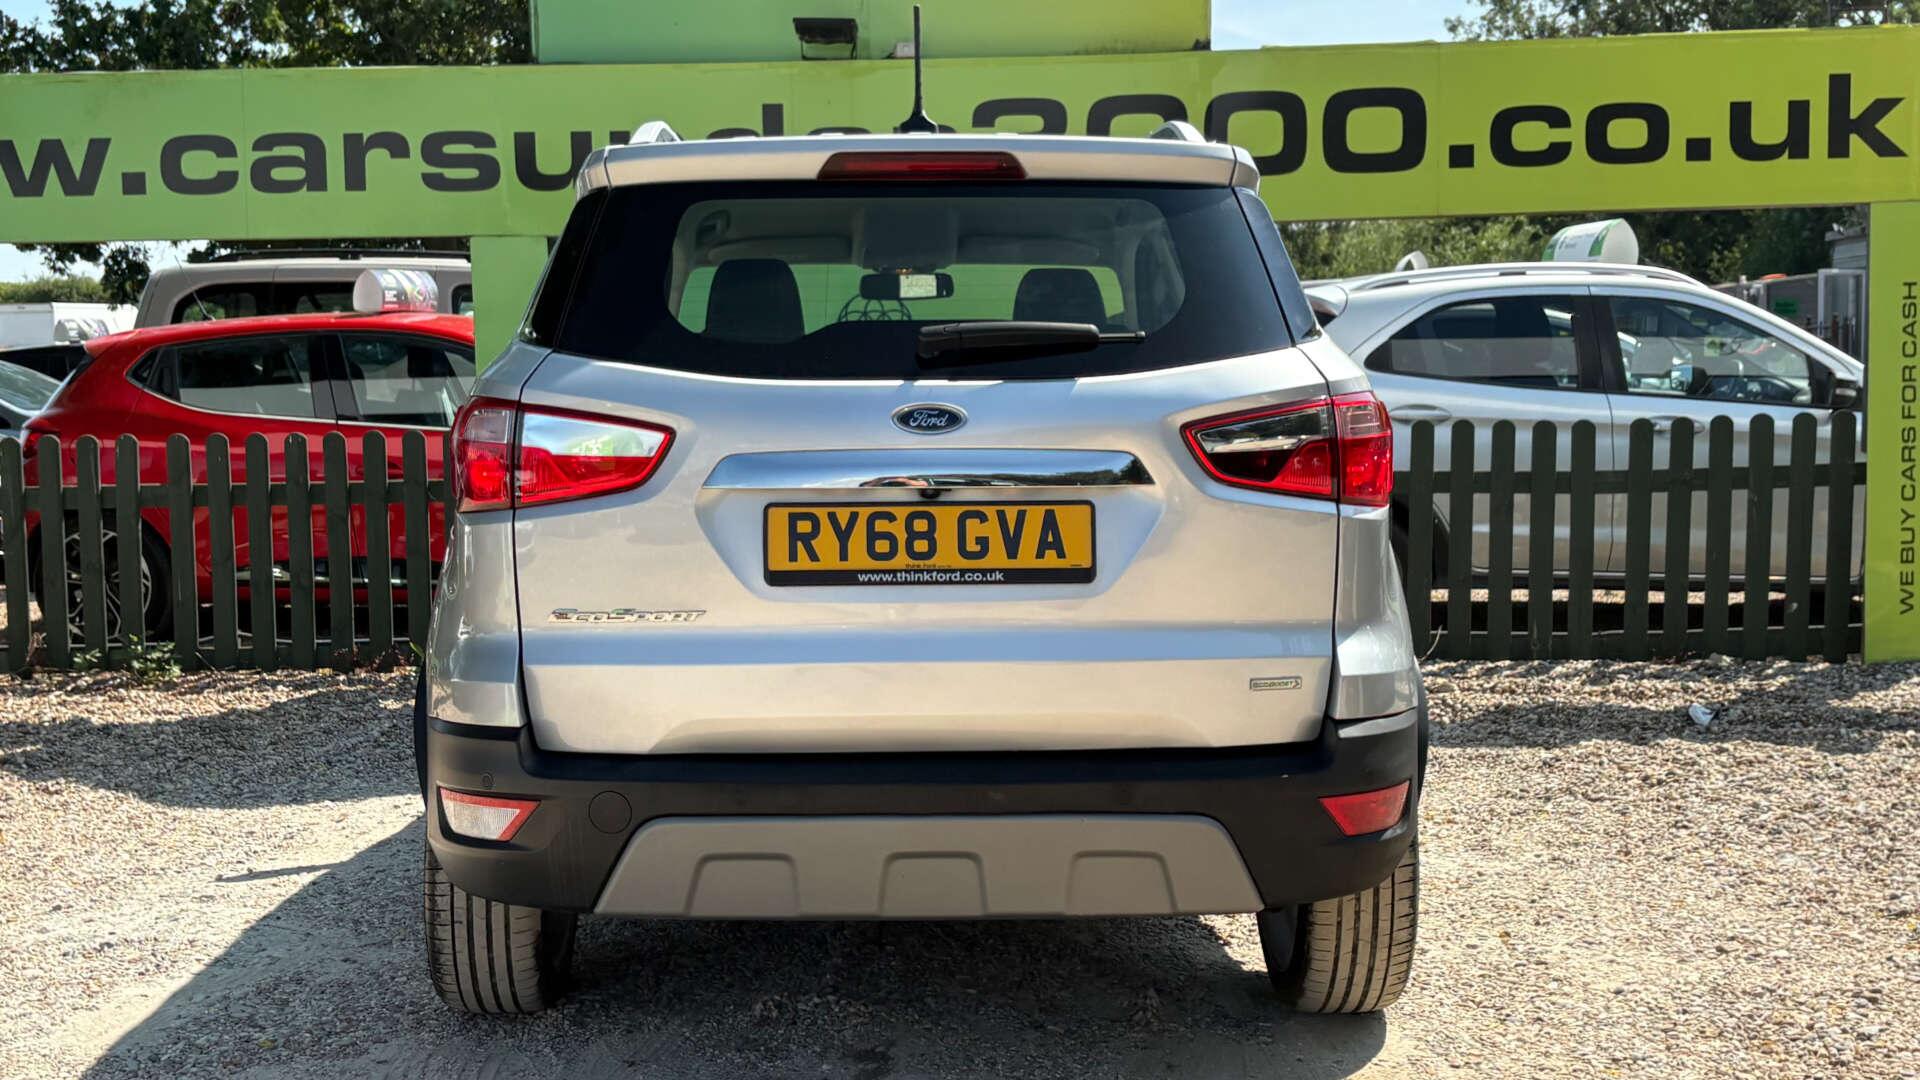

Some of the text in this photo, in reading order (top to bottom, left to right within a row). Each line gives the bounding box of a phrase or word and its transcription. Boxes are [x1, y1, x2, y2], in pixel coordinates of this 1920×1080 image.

[910, 410, 948, 426] Ford
[1900, 282, 1917, 615] WE BUY CARS FOR CASH
[788, 508, 1067, 563] RY68 GVA
[858, 571, 1005, 583] www.thinkford.co.uk
